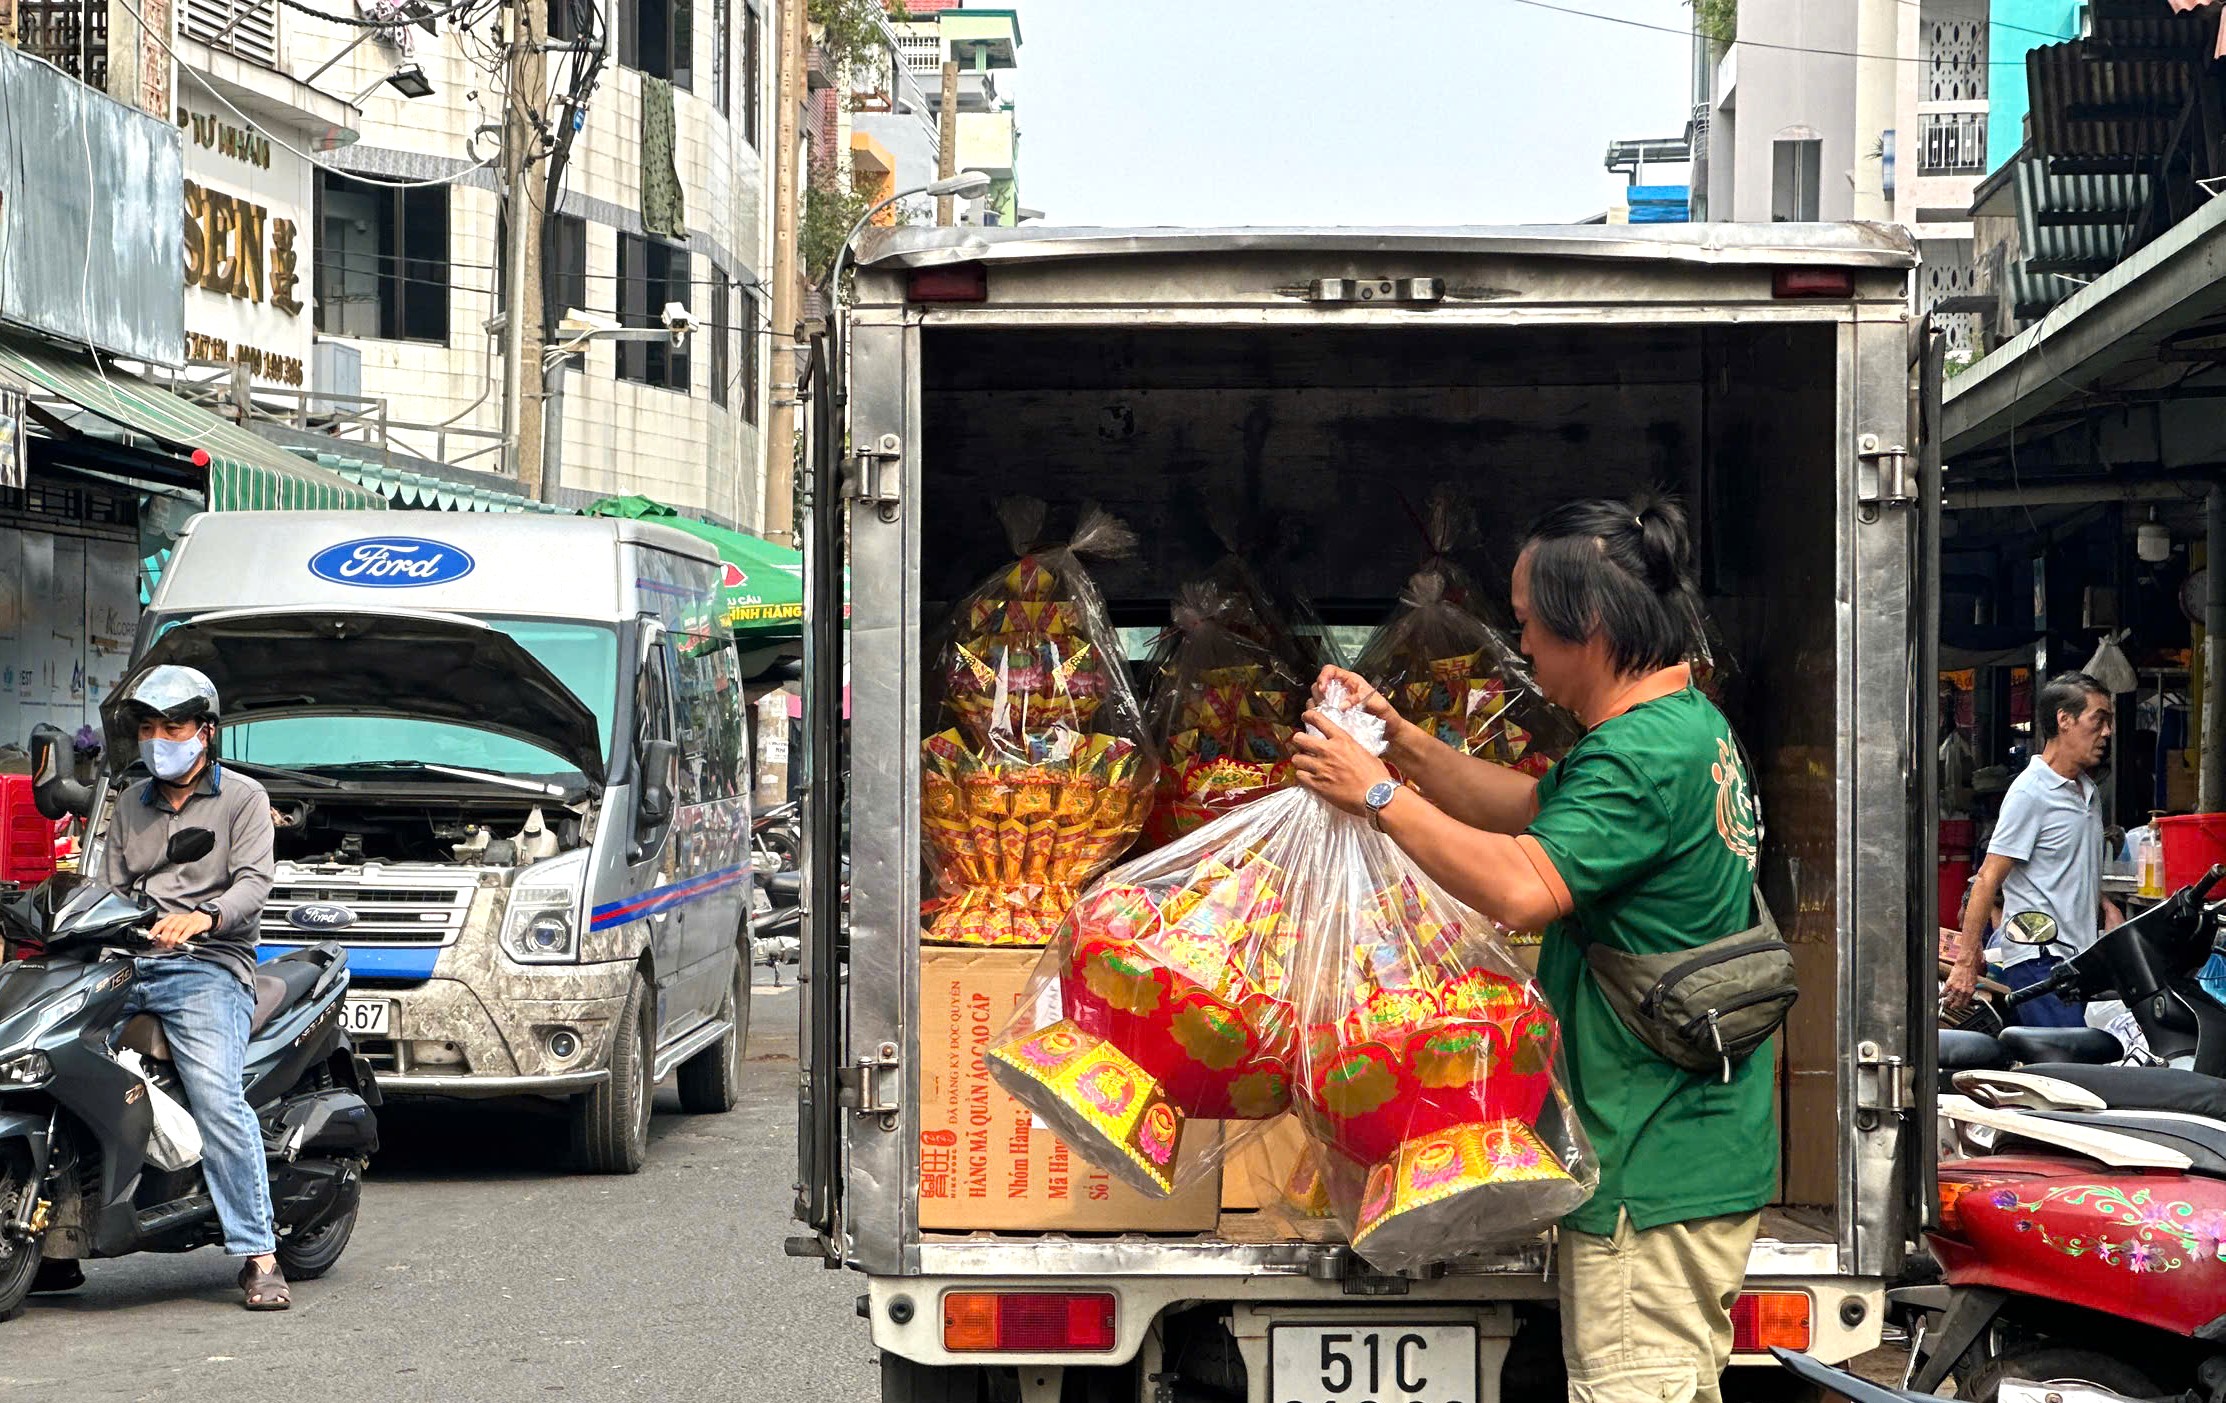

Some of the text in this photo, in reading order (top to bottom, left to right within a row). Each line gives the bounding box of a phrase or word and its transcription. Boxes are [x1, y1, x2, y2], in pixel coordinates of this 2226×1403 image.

[183, 179, 267, 304] SEN
[339, 544, 444, 578] Ford
[302, 906, 340, 924] Ford
[965, 1060, 989, 1081] ÁO
[965, 1130, 988, 1152] MÃ
[964, 1156, 987, 1198] HÀNG
[1008, 1159, 1029, 1199] Nhóm
[1048, 1177, 1069, 1199] Mã
[1320, 1333, 1427, 1394] 51C
